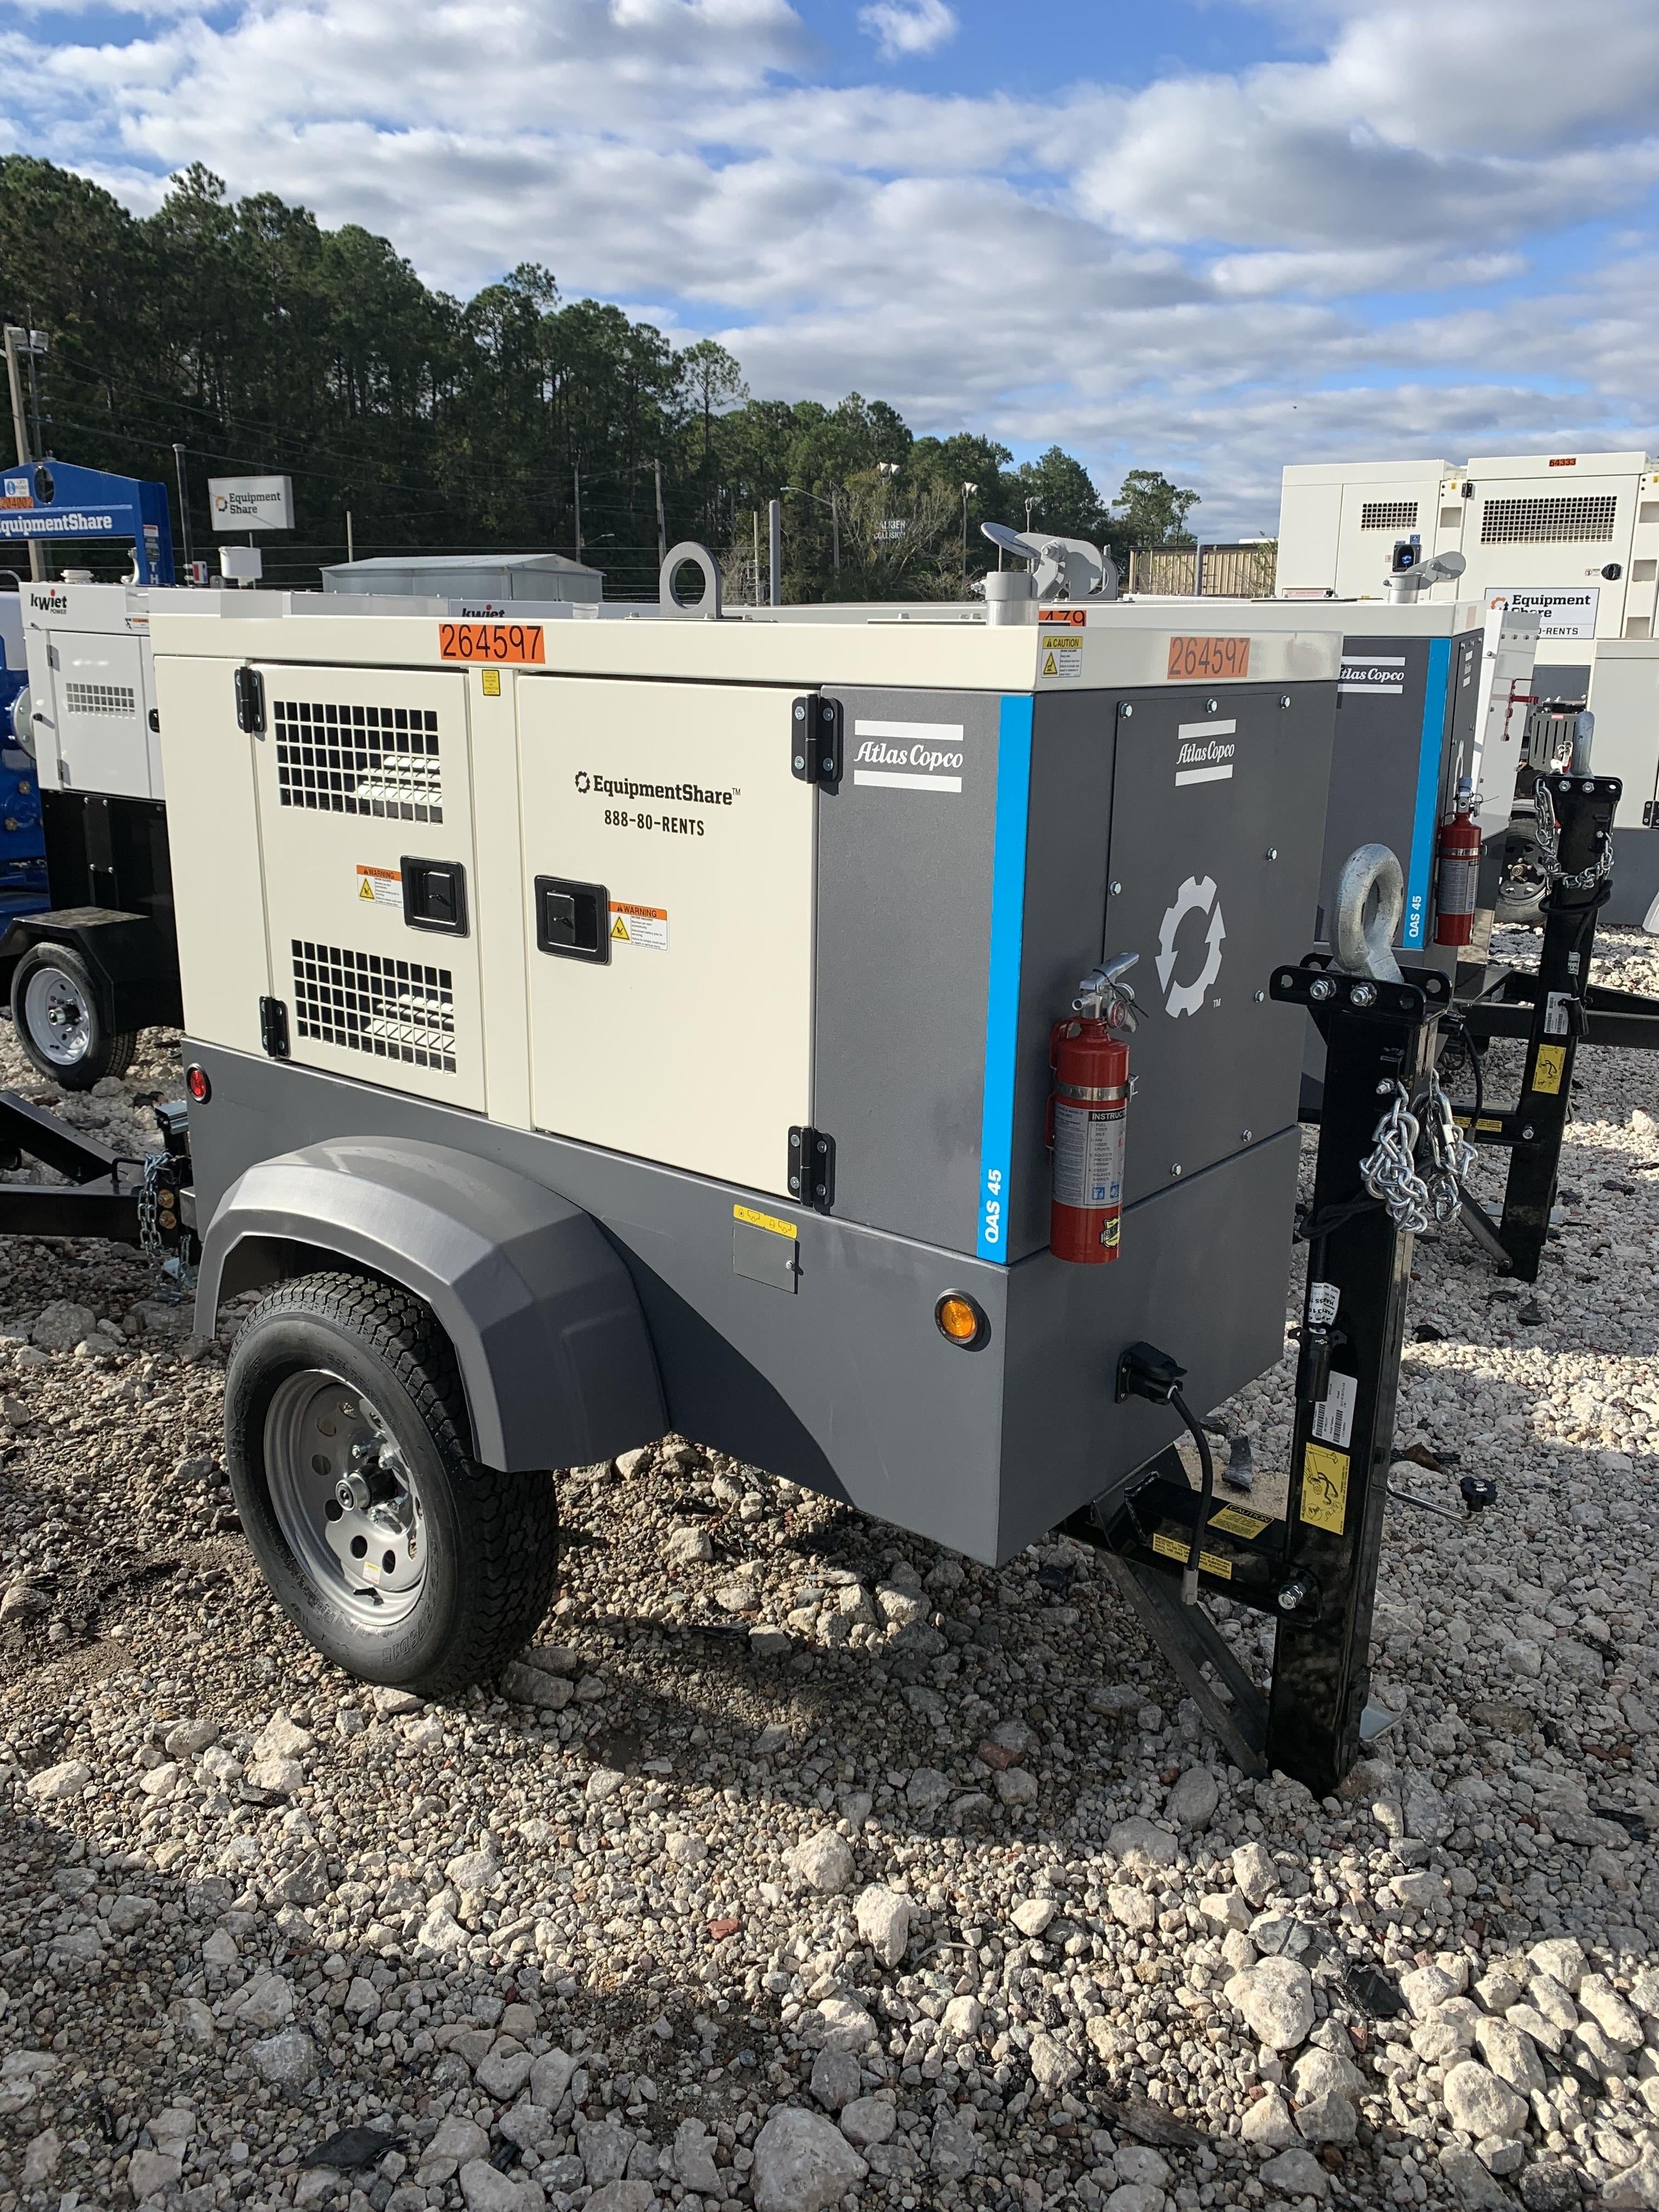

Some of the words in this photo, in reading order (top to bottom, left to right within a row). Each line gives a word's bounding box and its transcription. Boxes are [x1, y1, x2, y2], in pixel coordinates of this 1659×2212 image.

[229, 492, 281, 504] Equipment
[230, 505, 258, 514] Share
[0, 513, 112, 537] quipmentShare
[31, 589, 67, 610] kwiet
[1512, 594, 1591, 607] Equipment
[442, 624, 541, 659] 264597
[1053, 639, 1079, 647] CAUTION
[1169, 637, 1250, 677] 264597
[1368, 668, 1405, 683] Copco
[854, 741, 908, 766] Atlas
[909, 743, 963, 771] Copco
[1176, 743, 1207, 765] Atlas
[1207, 740, 1235, 763] Copco
[604, 809, 705, 837] 888-80-RENTS
[369, 868, 394, 879] WARNING
[624, 905, 657, 917] WARNING
[1411, 895, 1422, 911] 45
[1408, 913, 1420, 938] QAS
[989, 1169, 1002, 1197] 45
[984, 1200, 1000, 1243] QAS
[1229, 1505, 1270, 1522] CAUTION
